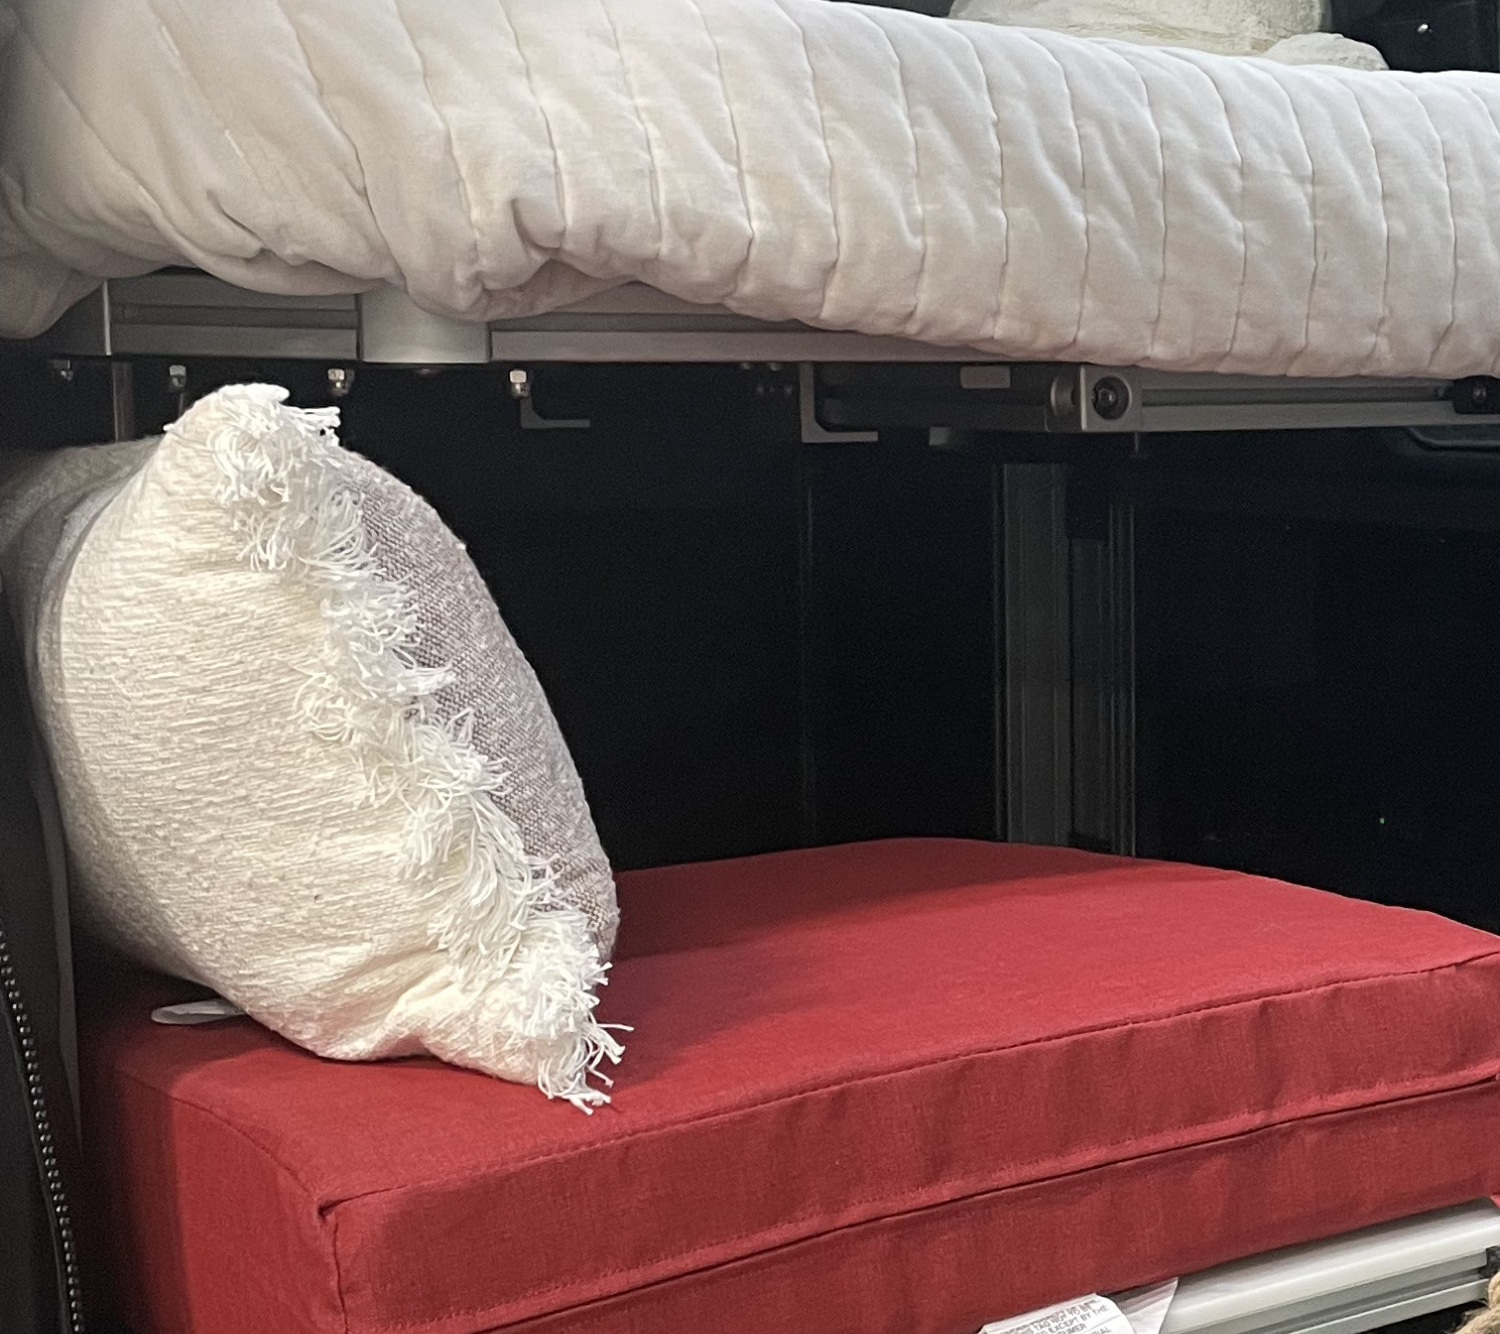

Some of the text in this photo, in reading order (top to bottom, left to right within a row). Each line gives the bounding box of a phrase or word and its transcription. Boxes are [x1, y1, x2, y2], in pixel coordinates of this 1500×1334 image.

[1034, 1320, 1051, 1332] TAG
[1050, 1312, 1067, 1325] NOT
[1048, 1318, 1080, 1334] EXCEPT
[1080, 1311, 1092, 1321] BY
[1093, 1304, 1110, 1316] THE
